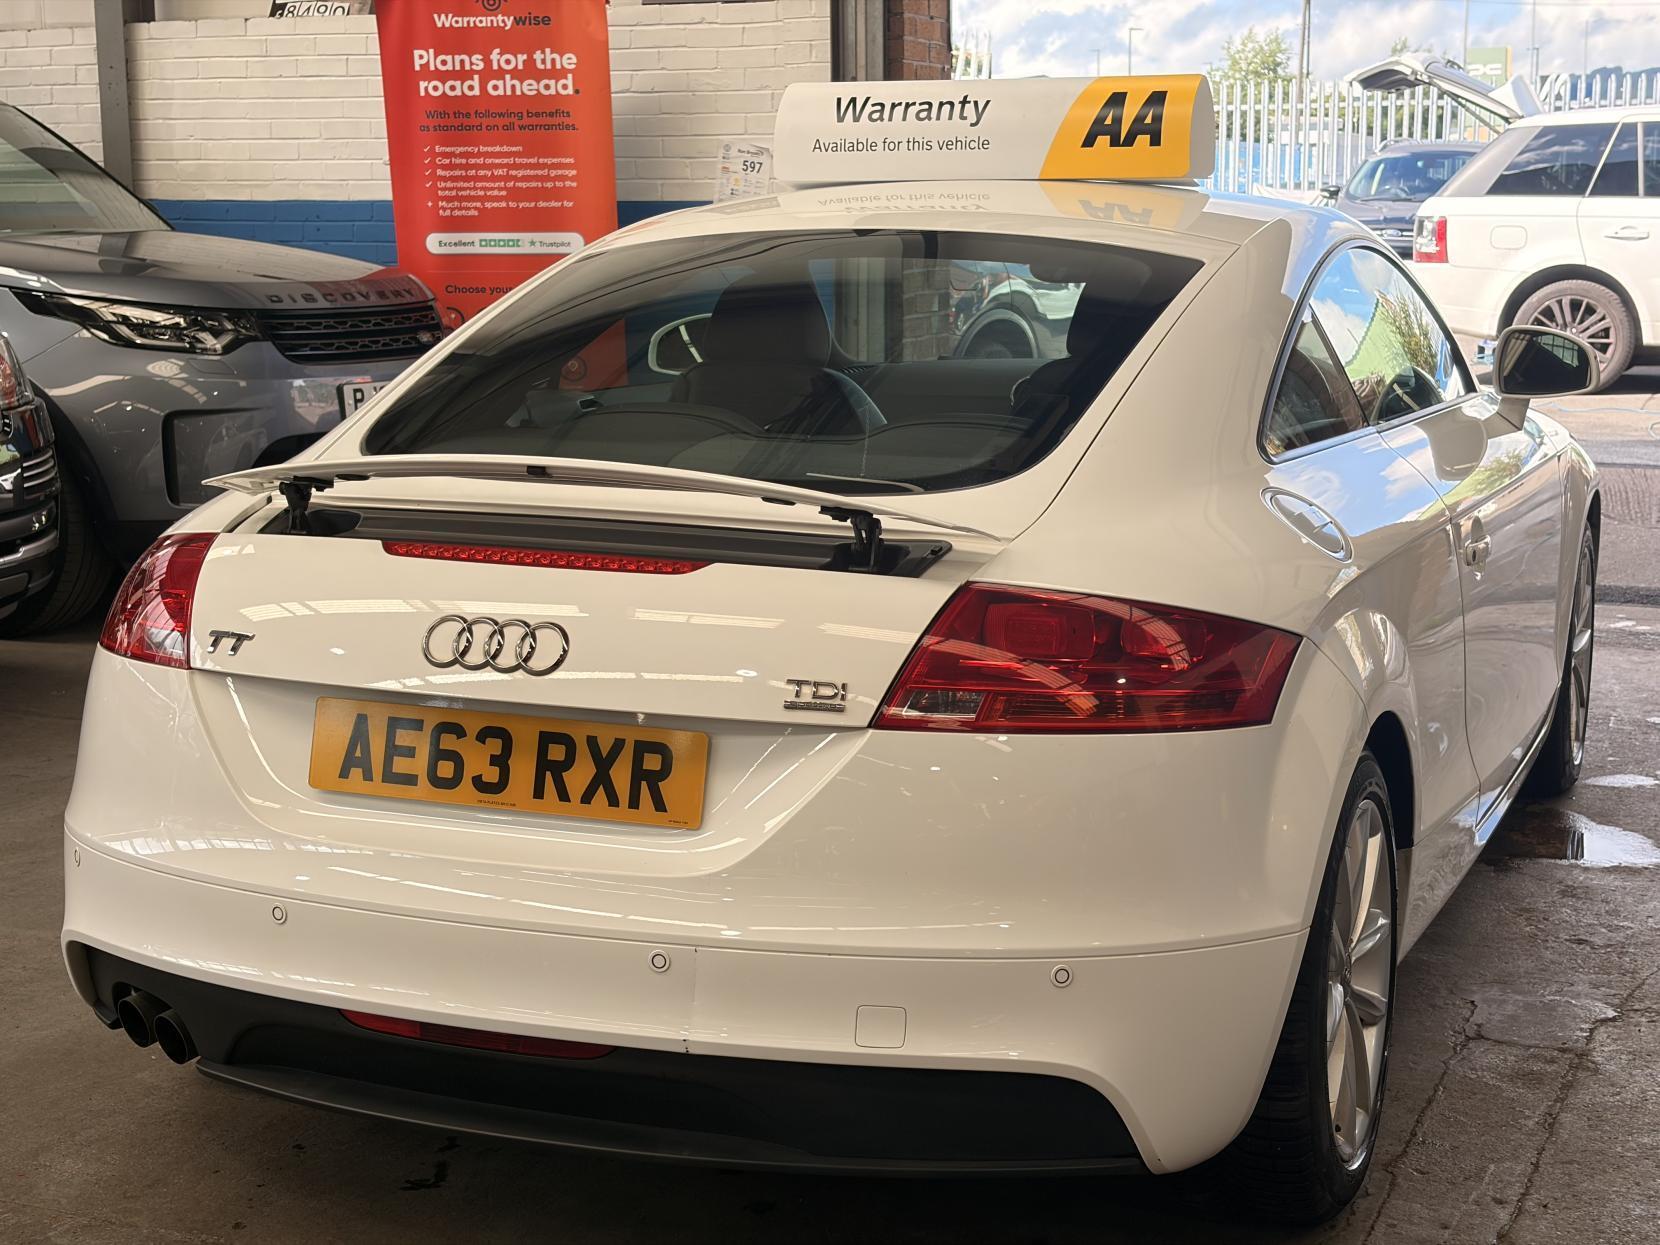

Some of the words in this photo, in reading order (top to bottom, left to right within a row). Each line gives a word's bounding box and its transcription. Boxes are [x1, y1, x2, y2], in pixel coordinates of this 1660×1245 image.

[433, 12, 551, 30] Warrantywise
[413, 48, 484, 71] Plans
[490, 48, 527, 70] for
[533, 48, 577, 69] the
[419, 74, 480, 97] road
[487, 74, 580, 96] ahead.
[425, 110, 450, 119] With
[453, 109, 471, 119] the
[474, 109, 523, 120] following
[526, 108, 571, 119] benefits
[835, 94, 991, 127] Warranty
[1080, 91, 1168, 148] AA
[419, 124, 430, 132] as
[432, 122, 482, 132] standard
[485, 124, 499, 132] on
[502, 122, 515, 132] all
[518, 122, 579, 132] warranties.
[435, 145, 478, 154] Emergency
[479, 145, 523, 153] breakdown
[812, 138, 878, 153] Available
[882, 137, 902, 152] for
[906, 137, 933, 151] this
[937, 136, 990, 151] vehicle
[515, 156, 537, 164] travel
[538, 157, 575, 165] expenses
[742, 160, 763, 174] 597
[436, 168, 466, 177] Repairs
[477, 169, 492, 177] any
[493, 168, 508, 176] VAT
[509, 168, 548, 177] registered
[549, 169, 577, 177] garage
[437, 180, 474, 188] Unlimited
[515, 181, 541, 189] repairs
[543, 181, 554, 189] up
[564, 180, 577, 188] the
[484, 201, 507, 209] speak
[439, 209, 451, 217] full
[452, 209, 478, 217] details
[438, 240, 475, 248] Excellent
[539, 240, 571, 249] Trustpilot
[266, 288, 416, 304] DISCOVERY
[445, 284, 486, 295] Choose
[207, 629, 256, 656] TT
[786, 678, 848, 701] TDI
[338, 712, 514, 796] AE63
[532, 729, 674, 814] RXR
